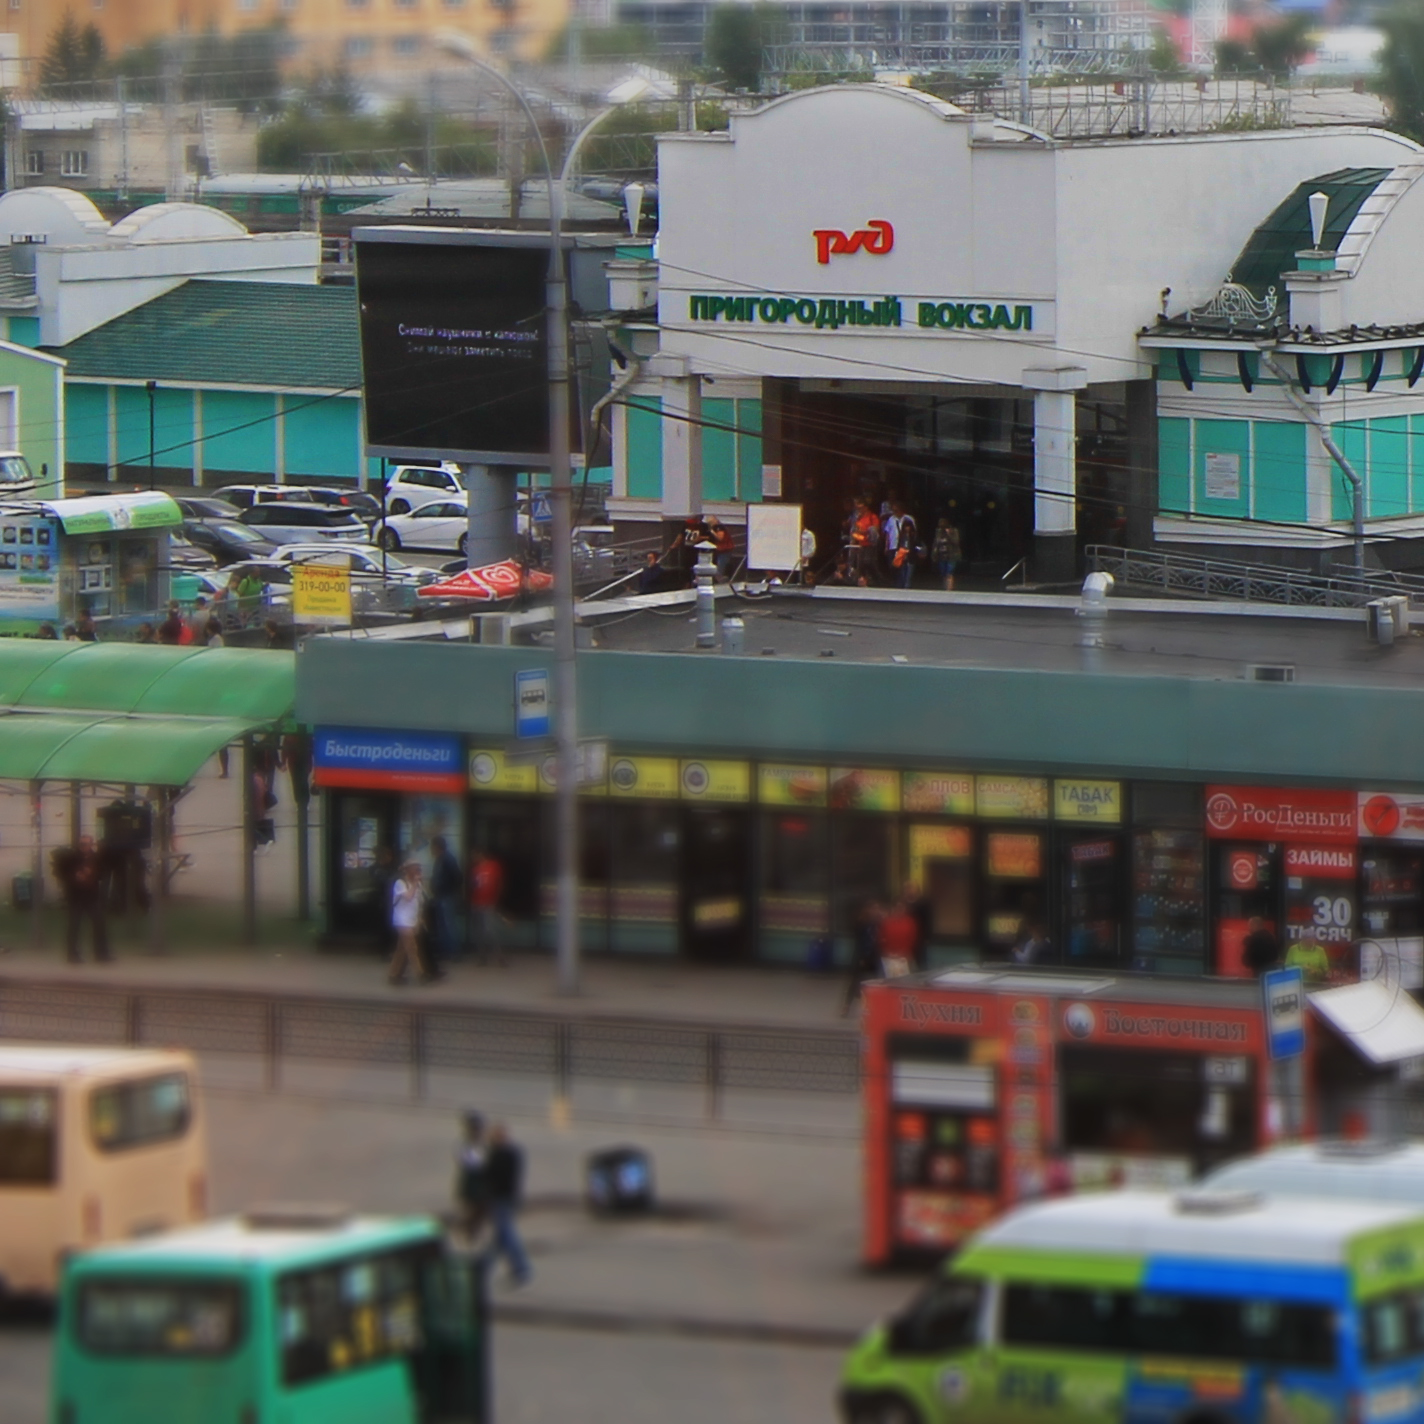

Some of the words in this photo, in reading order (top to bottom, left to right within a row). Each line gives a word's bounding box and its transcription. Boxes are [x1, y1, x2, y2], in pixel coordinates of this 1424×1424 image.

[689, 295, 902, 330] ПРИГОРОДНЫЙ
[917, 302, 1033, 332] ВОКЗАЛ
[299, 580, 346, 593] 319-00-00
[324, 739, 452, 763] Быстроденьги
[930, 779, 971, 795] ПЛОВ
[977, 782, 1018, 795] САМСА
[1061, 785, 1114, 804] ТАБАК
[1241, 802, 1353, 832] РосДеньги
[1286, 848, 1354, 869] ЗАЙМЫ
[1312, 895, 1352, 927] 30
[900, 995, 984, 1029] Кухня
[1103, 1008, 1249, 1043] Восточная
